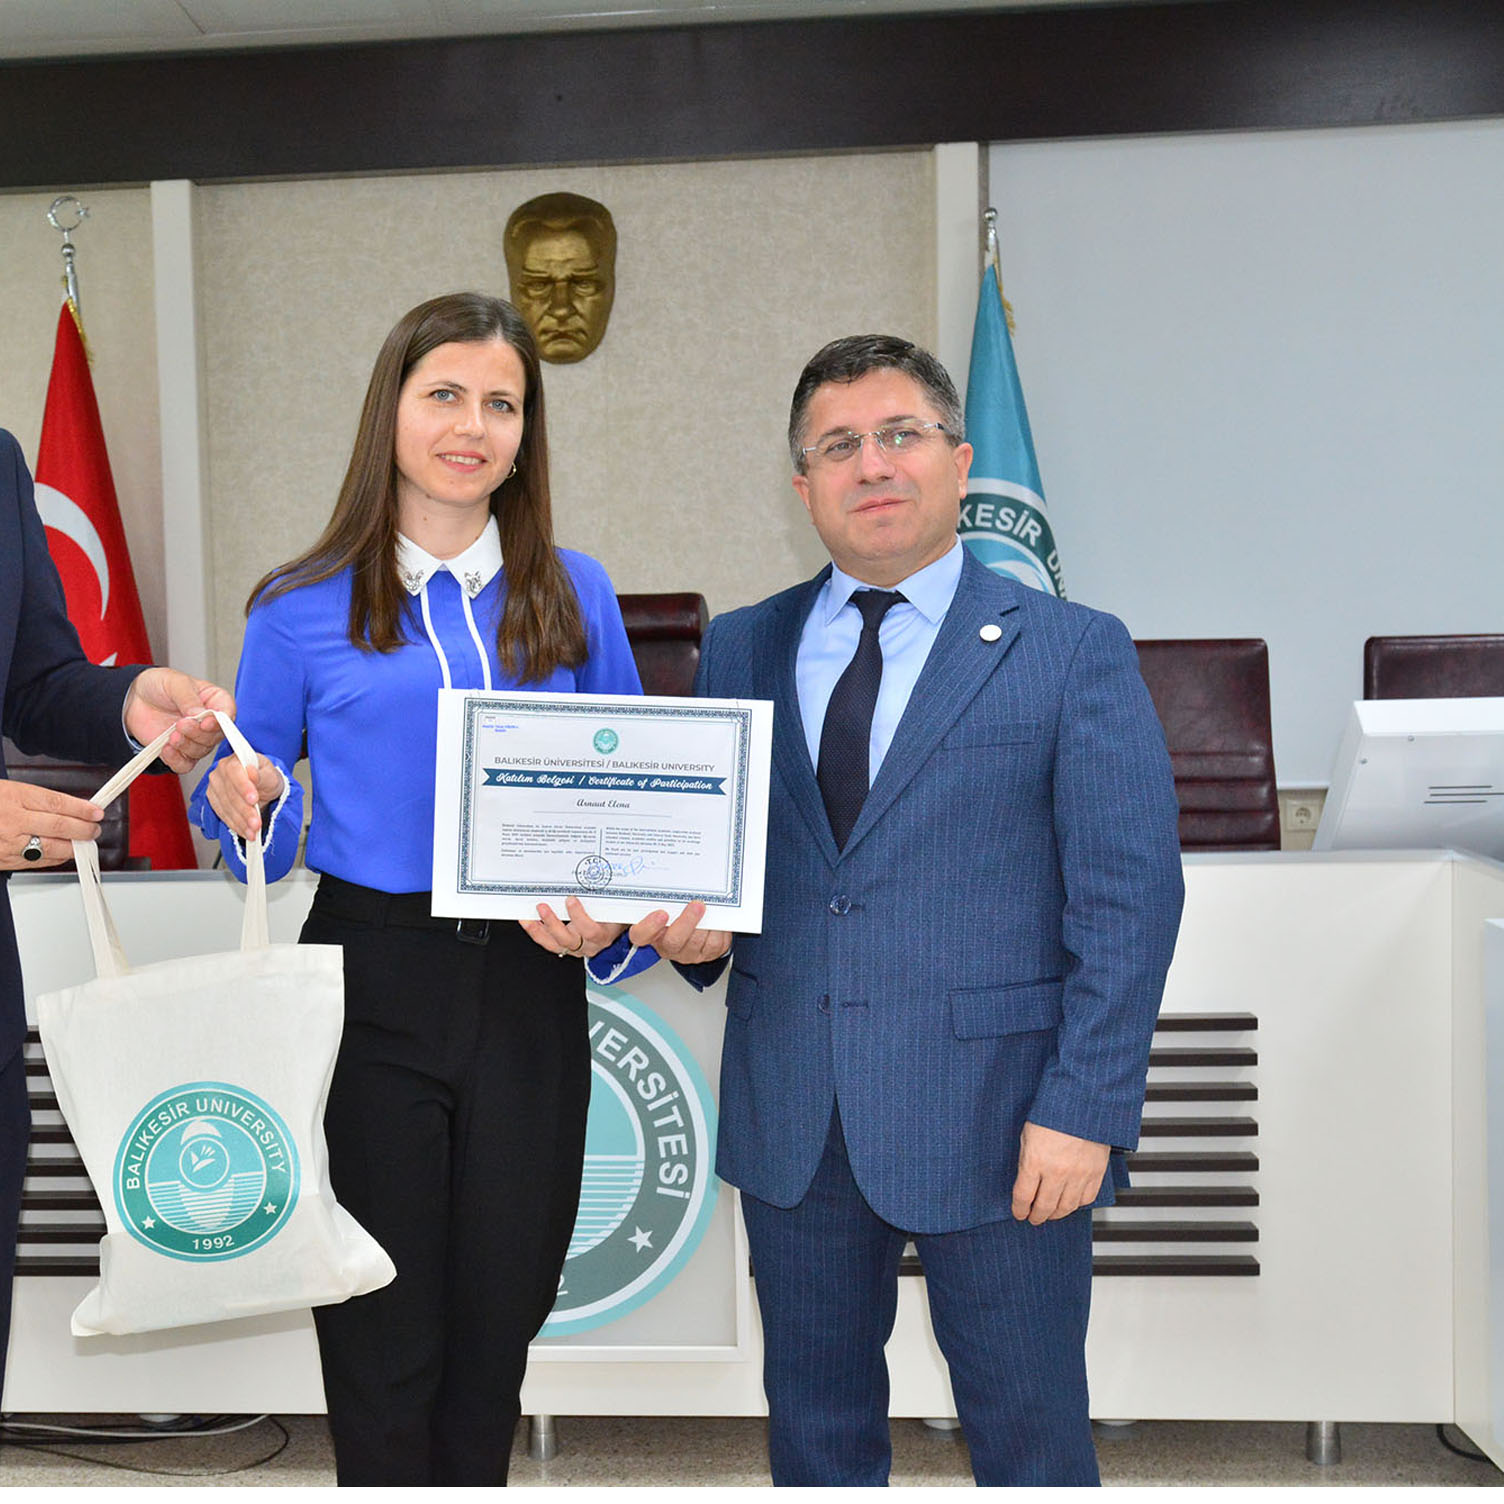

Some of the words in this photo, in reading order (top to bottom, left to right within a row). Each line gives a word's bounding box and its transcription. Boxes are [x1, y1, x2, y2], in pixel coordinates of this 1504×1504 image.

[661, 763, 715, 773] UNIVERSITY
[536, 774, 575, 787] Belgesi
[588, 775, 635, 788] Certificate
[637, 777, 648, 789] of
[650, 777, 713, 791] Participation
[126, 1101, 190, 1190] BALIKESİR
[195, 1097, 287, 1174] UNIVERSITY
[191, 1234, 235, 1250] 1992
